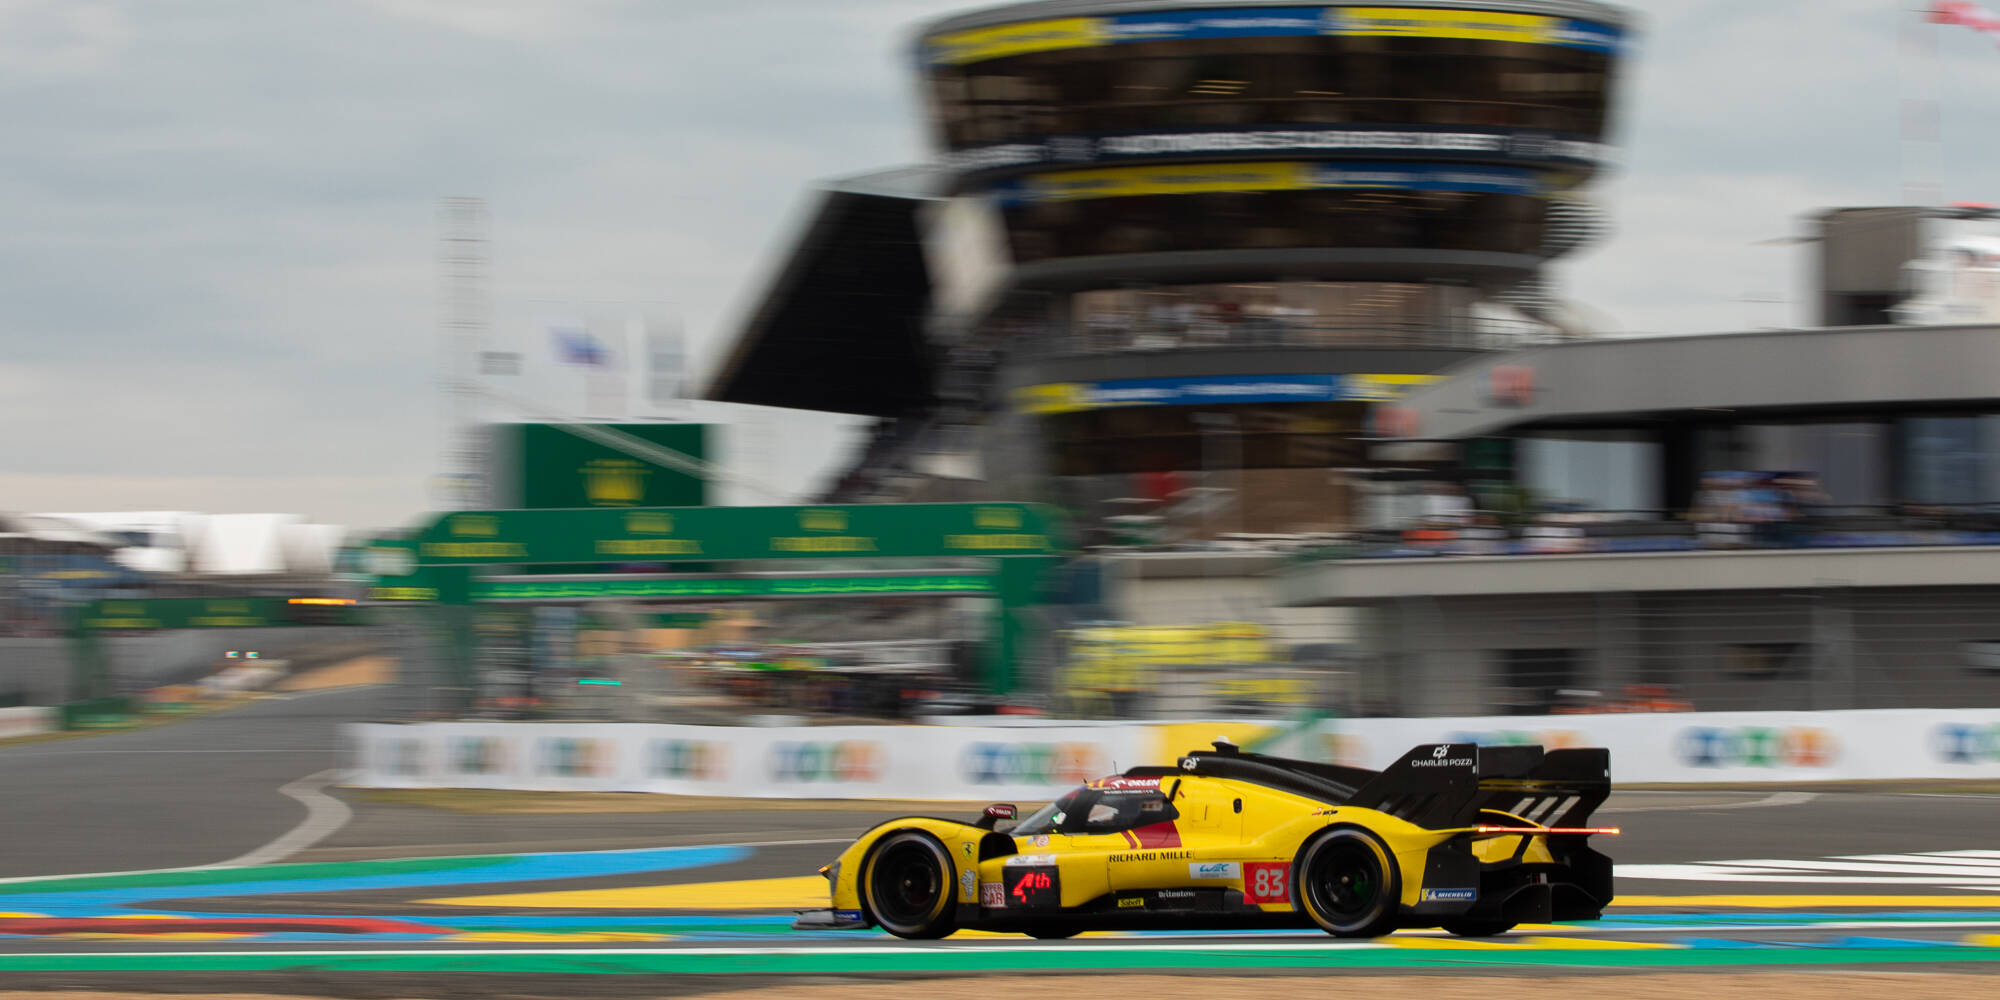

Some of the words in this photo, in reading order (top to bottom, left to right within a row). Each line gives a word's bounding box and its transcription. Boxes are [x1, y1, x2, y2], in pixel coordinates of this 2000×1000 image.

[1411, 759, 1448, 767] CHARLES
[1449, 758, 1473, 767] POZZI
[1127, 779, 1160, 787] ORLEN
[1108, 852, 1156, 863] RICHARD
[1159, 850, 1192, 860] MILLE
[1012, 872, 1052, 904] 4th
[1255, 868, 1284, 897] 83
[982, 891, 1004, 905] CAR
